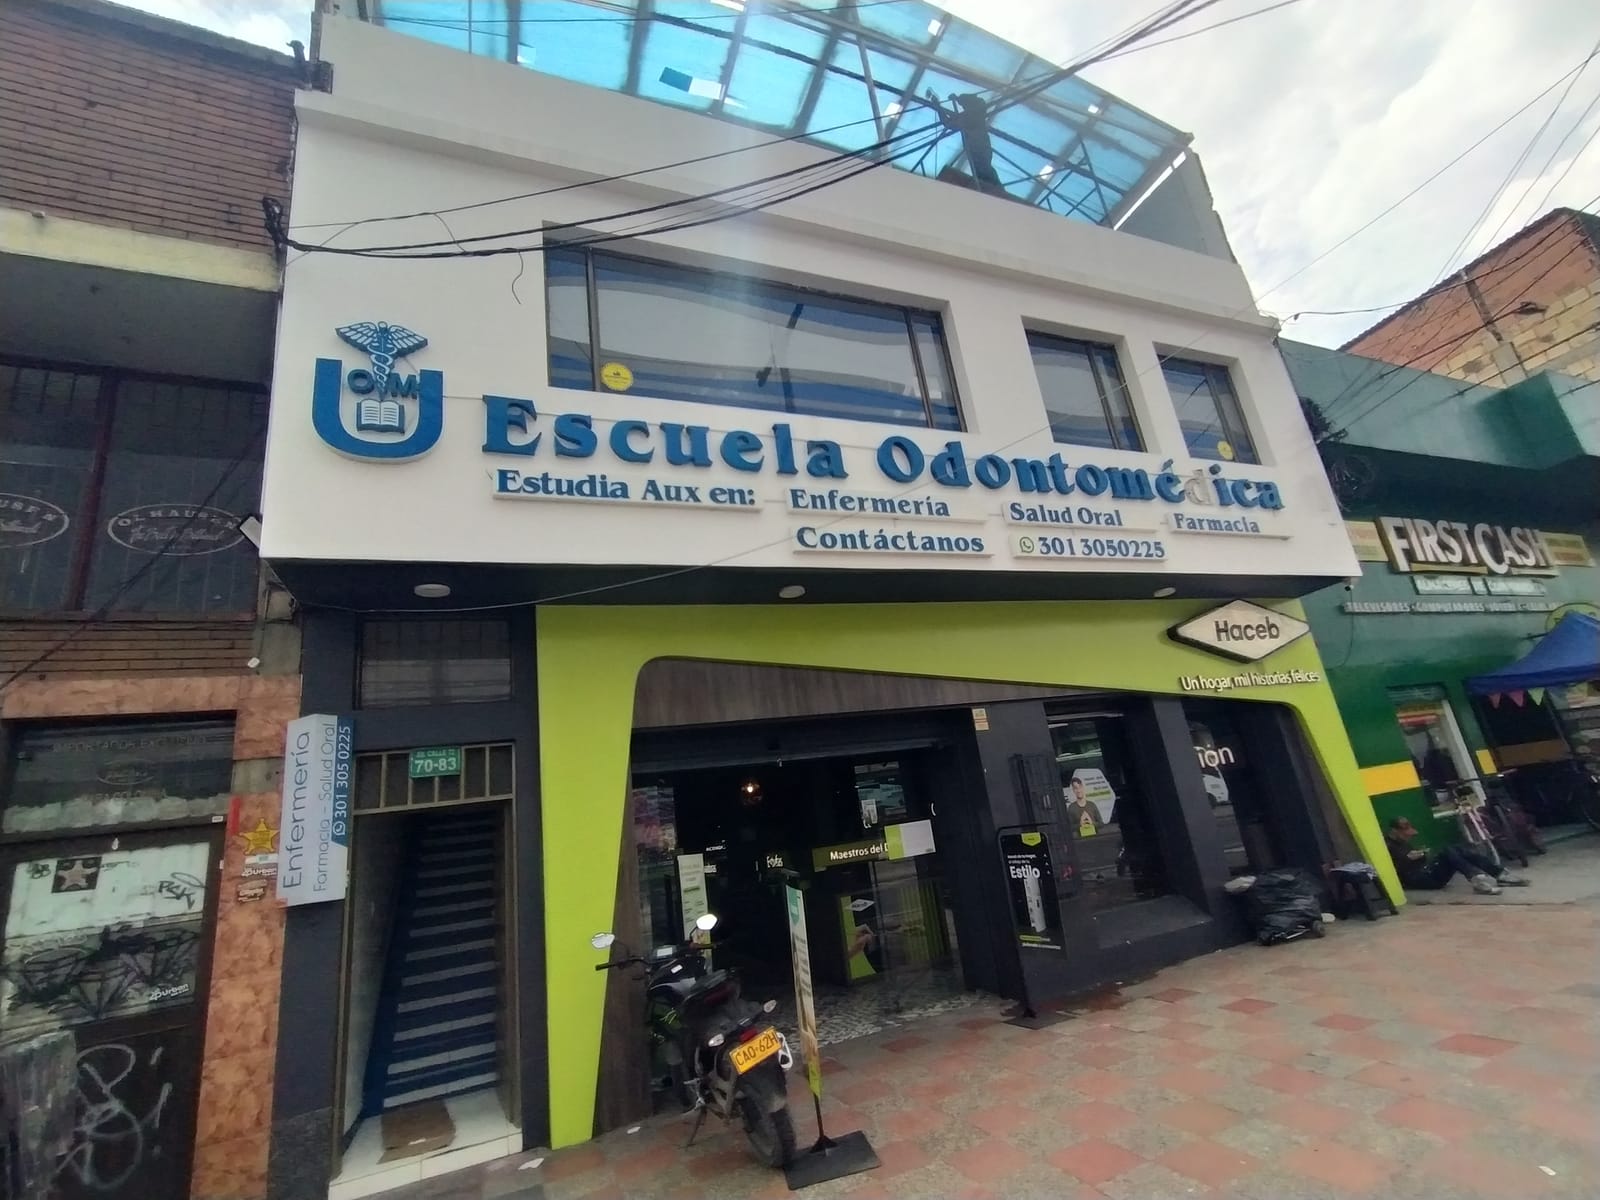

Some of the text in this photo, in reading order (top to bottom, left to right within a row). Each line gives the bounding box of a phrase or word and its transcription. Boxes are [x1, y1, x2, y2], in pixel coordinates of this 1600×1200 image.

[482, 394, 1285, 510] Escuela Odontomédica
[497, 468, 755, 505] Estudia Aux en:
[790, 488, 950, 516] Enfermería
[1010, 502, 1123, 527] Salud Oral
[796, 526, 985, 552] Contáctanos
[1038, 537, 1165, 558] 301 3050225
[1214, 616, 1281, 642] Haceb
[1181, 676, 1200, 690] Un
[1199, 675, 1234, 692] hogar,
[1233, 673, 1250, 687] mil
[1249, 670, 1291, 686] historias
[321, 723, 336, 755] Oral
[334, 726, 351, 818] 301 305 0225
[414, 757, 457, 773] 70-83
[318, 759, 333, 801] Salud
[283, 731, 310, 888] Enfermería
[313, 819, 331, 892] Farmacia
[830, 848, 869, 861] Maestros
[870, 843, 883, 854] del
[1009, 864, 1041, 880] Estilo
